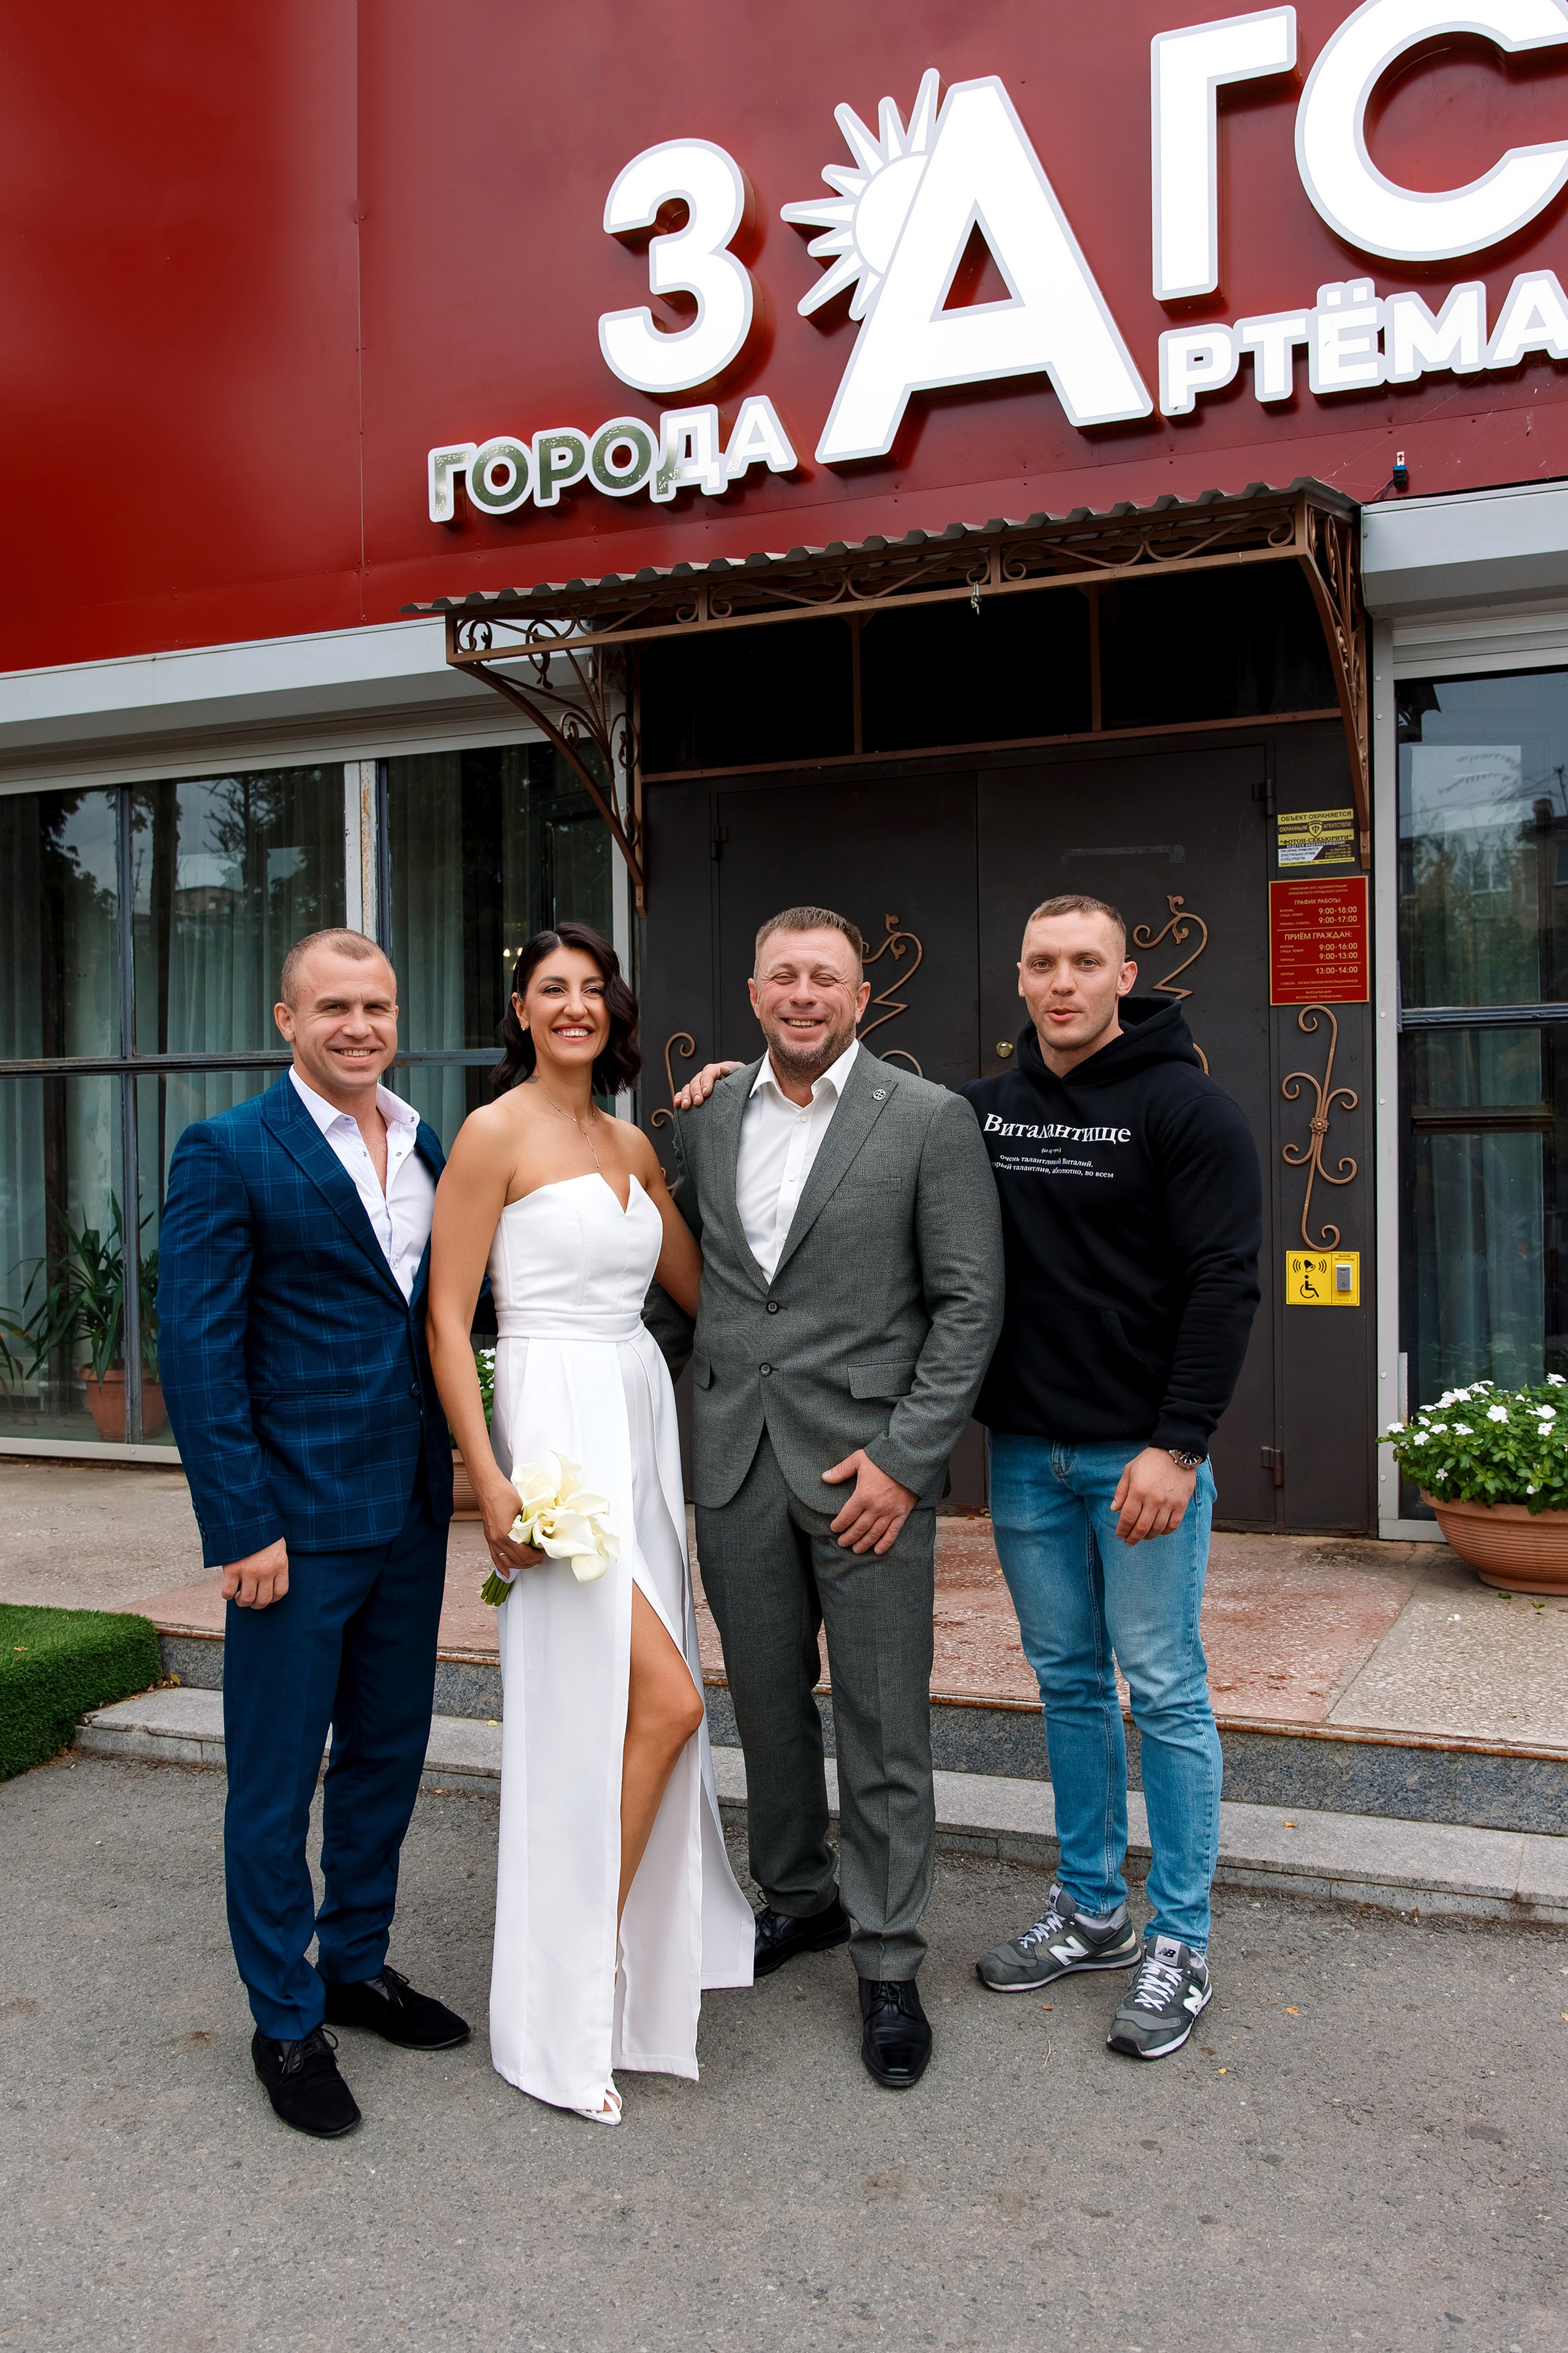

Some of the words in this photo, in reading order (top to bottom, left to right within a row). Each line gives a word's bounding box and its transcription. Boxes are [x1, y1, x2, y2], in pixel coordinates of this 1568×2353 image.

[599, 0, 1568, 464] ЗАГС
[428, 395, 797, 524] ГОРОДА
[1308, 811, 1351, 820] ОХРАНЯЕТСЯ
[1319, 906, 1357, 915] 9:00-18:00
[1319, 915, 1357, 924] 9:00-17:00
[1284, 932, 1311, 941] ПРИЁМ
[1319, 942, 1358, 951] 9:00-16:00
[1319, 951, 1358, 960] 9:00-13:00
[1315, 966, 1358, 975] 13:00-14:00
[983, 1113, 1131, 1144] Виталантище
[1062, 1158, 1093, 1168] Виталий.
[1012, 1165, 1050, 1174] талантлив,
